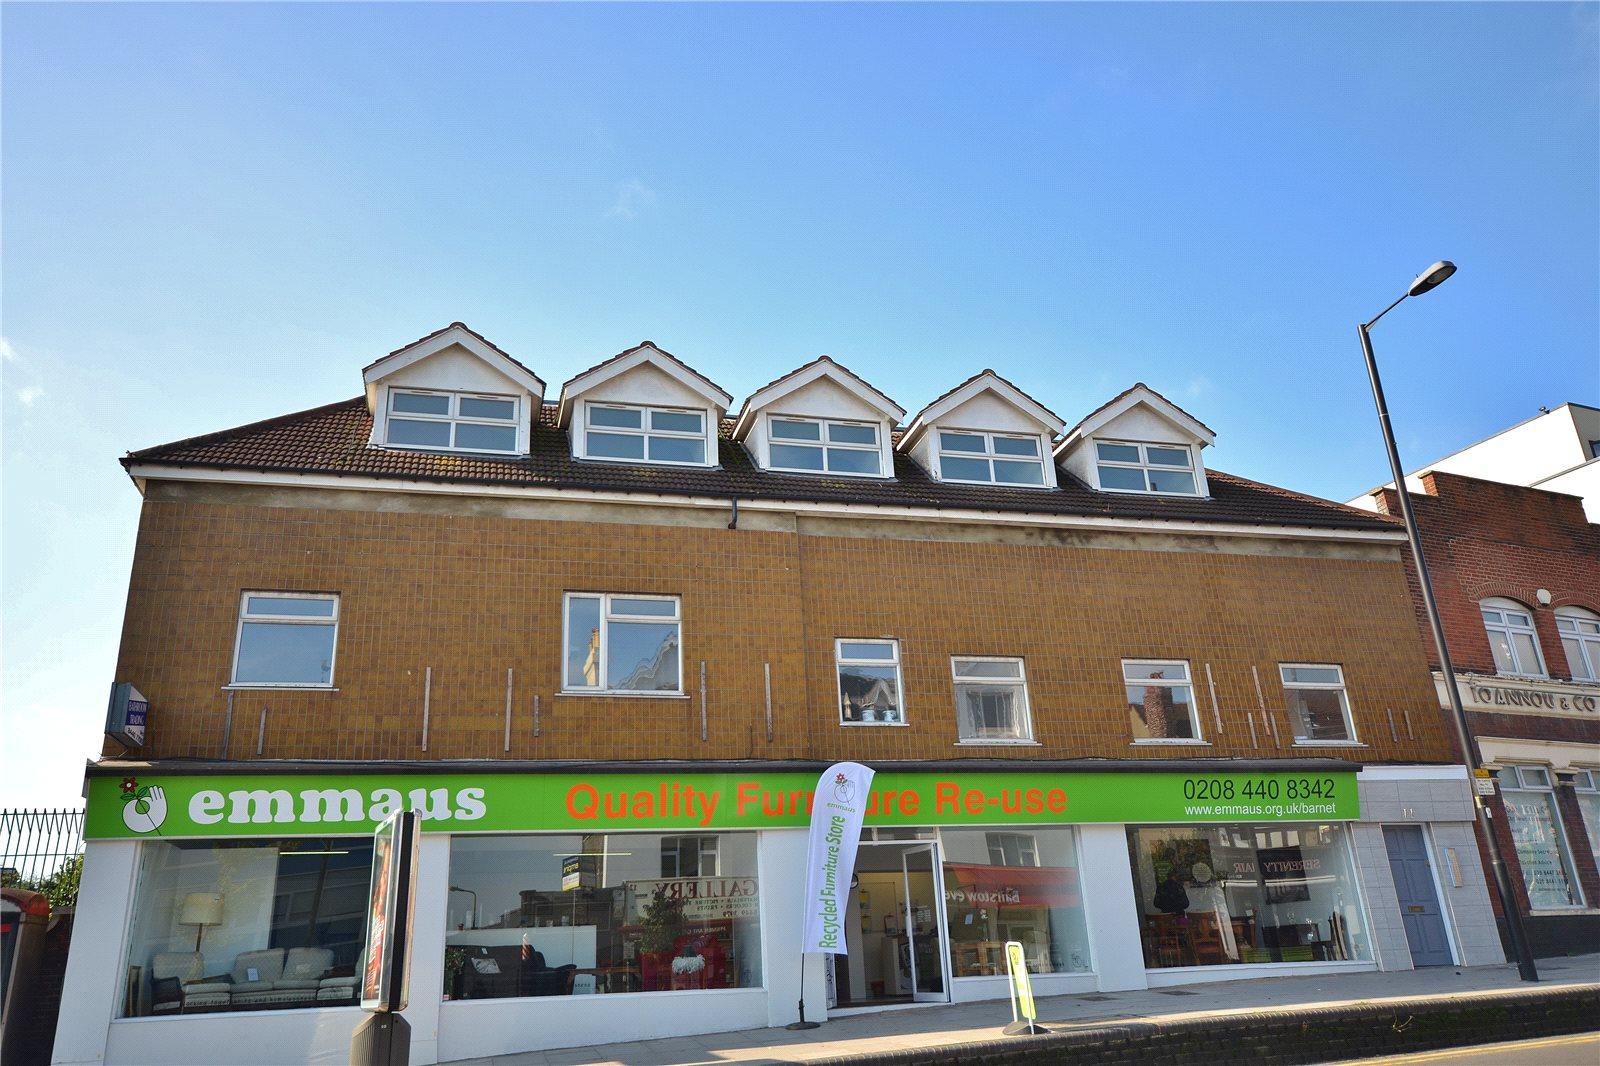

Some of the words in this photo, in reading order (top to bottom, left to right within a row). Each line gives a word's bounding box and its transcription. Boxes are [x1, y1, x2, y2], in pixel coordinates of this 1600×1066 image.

[1471, 686, 1554, 709] IOANNOU
[1560, 697, 1570, 710] &
[1573, 694, 1596, 712] CO
[566, 783, 720, 827] Quality
[736, 783, 920, 816] Furure
[935, 782, 1068, 815] Re-use
[1183, 779, 1235, 799] 0208
[1241, 779, 1279, 799] 440
[1286, 778, 1336, 799] 8342
[188, 787, 487, 824] emmaus
[1184, 801, 1336, 817] www.emmaus.org.uk/barnet
[825, 815, 846, 845] Store
[821, 847, 840, 896] Furniture
[818, 899, 838, 949] Recycled
